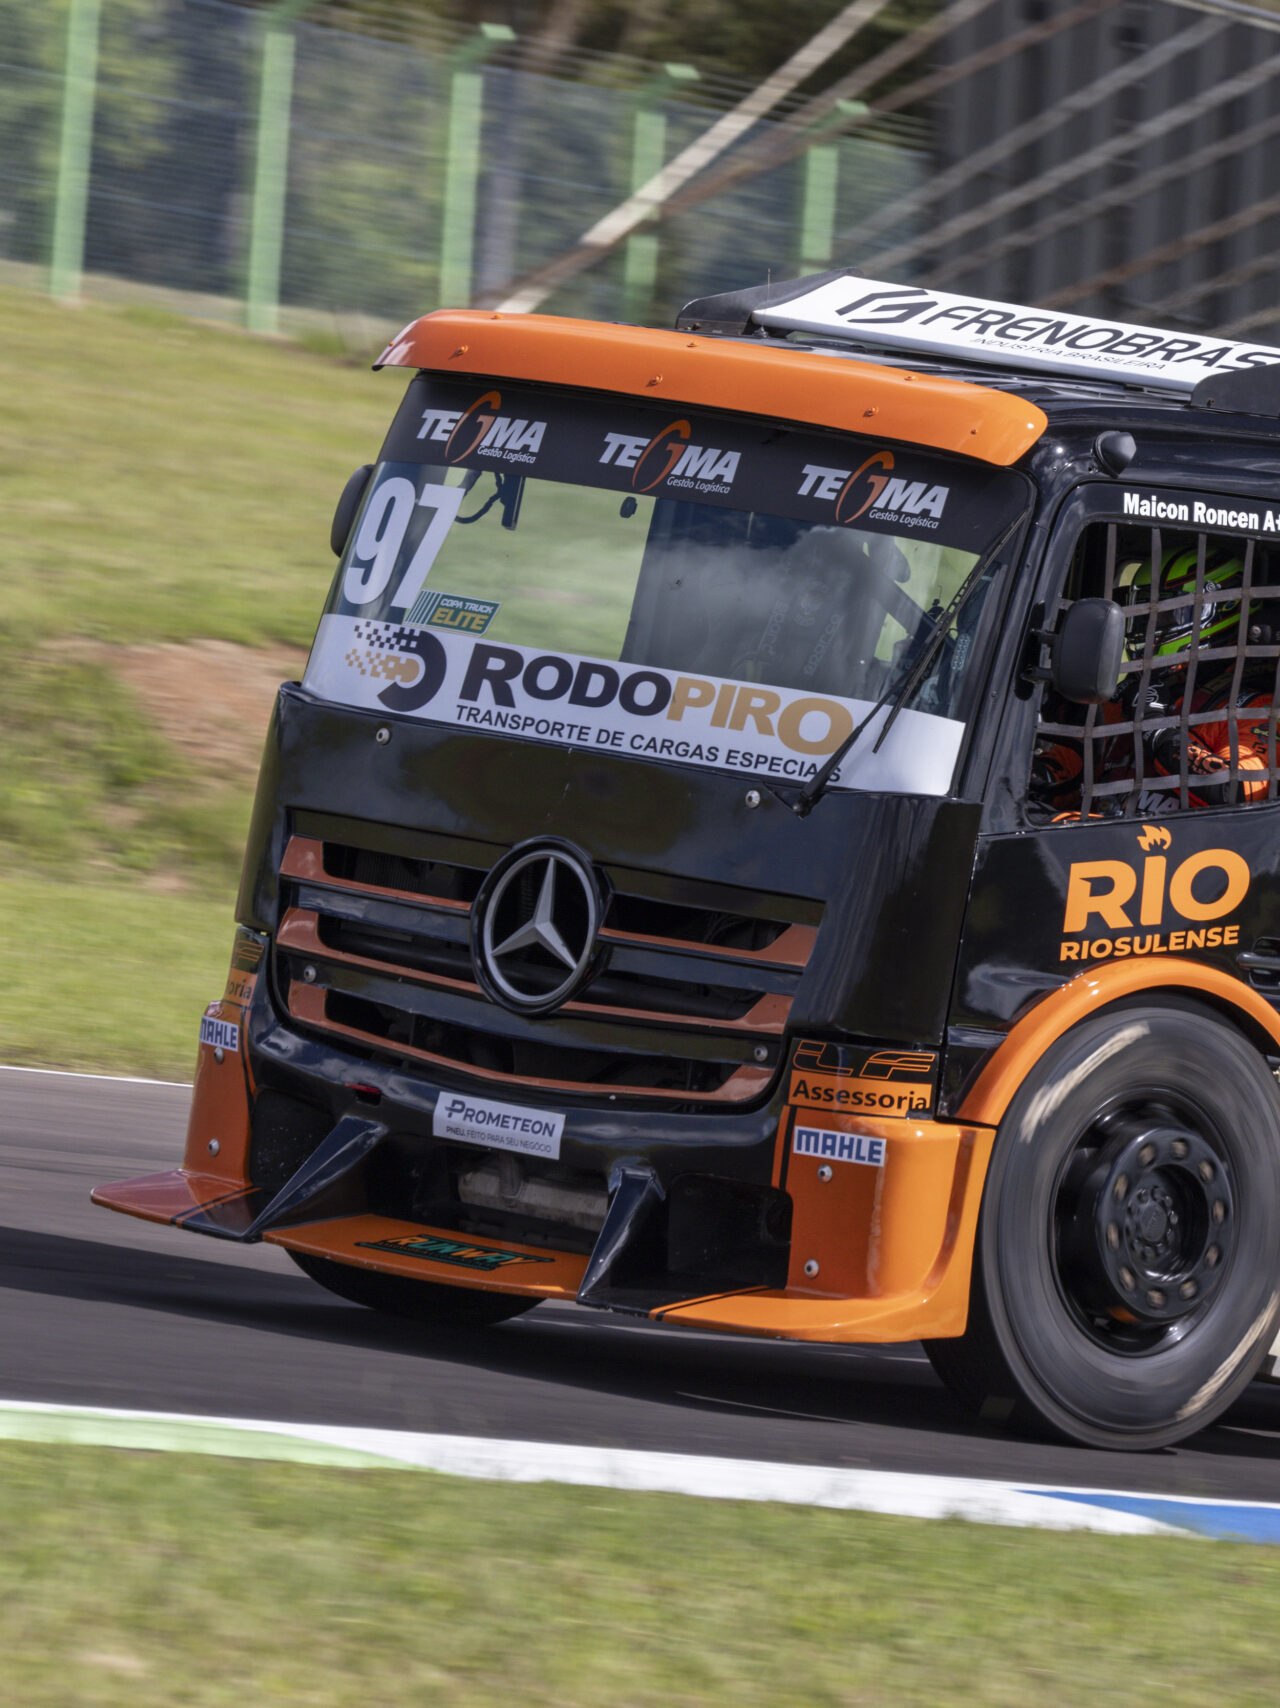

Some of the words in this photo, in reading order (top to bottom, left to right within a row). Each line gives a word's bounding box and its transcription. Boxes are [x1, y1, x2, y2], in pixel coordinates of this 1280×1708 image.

[1067, 351, 1166, 370] BRASILEIRA
[416, 391, 547, 463] TEGMA
[477, 445, 502, 458] Gestão
[502, 450, 536, 464] Logística
[599, 420, 741, 492] TEGMA
[667, 476, 695, 489] Gestão
[695, 480, 731, 494] Logística
[797, 451, 949, 523] TEGMA
[869, 509, 899, 522] Gestão
[899, 514, 939, 529] Logística
[1123, 492, 1189, 521] Maicon
[1193, 501, 1259, 530] Roncen
[343, 477, 465, 608] 97
[432, 607, 488, 630] ELITE
[440, 598, 463, 609] COPA
[464, 602, 494, 614] TRUCK
[459, 643, 853, 755] RODOPIRO
[456, 704, 591, 742] TRANSPORTE
[596, 728, 625, 747] DE
[630, 734, 719, 762] CARGAS
[725, 749, 842, 782] ESPECIAS
[1063, 848, 1250, 933] RIO
[1059, 925, 1240, 961] RIOSULENSE
[792, 1080, 930, 1112] Assessoria
[445, 1099, 556, 1137] PROMETEON
[796, 1129, 882, 1164] MAHLE
